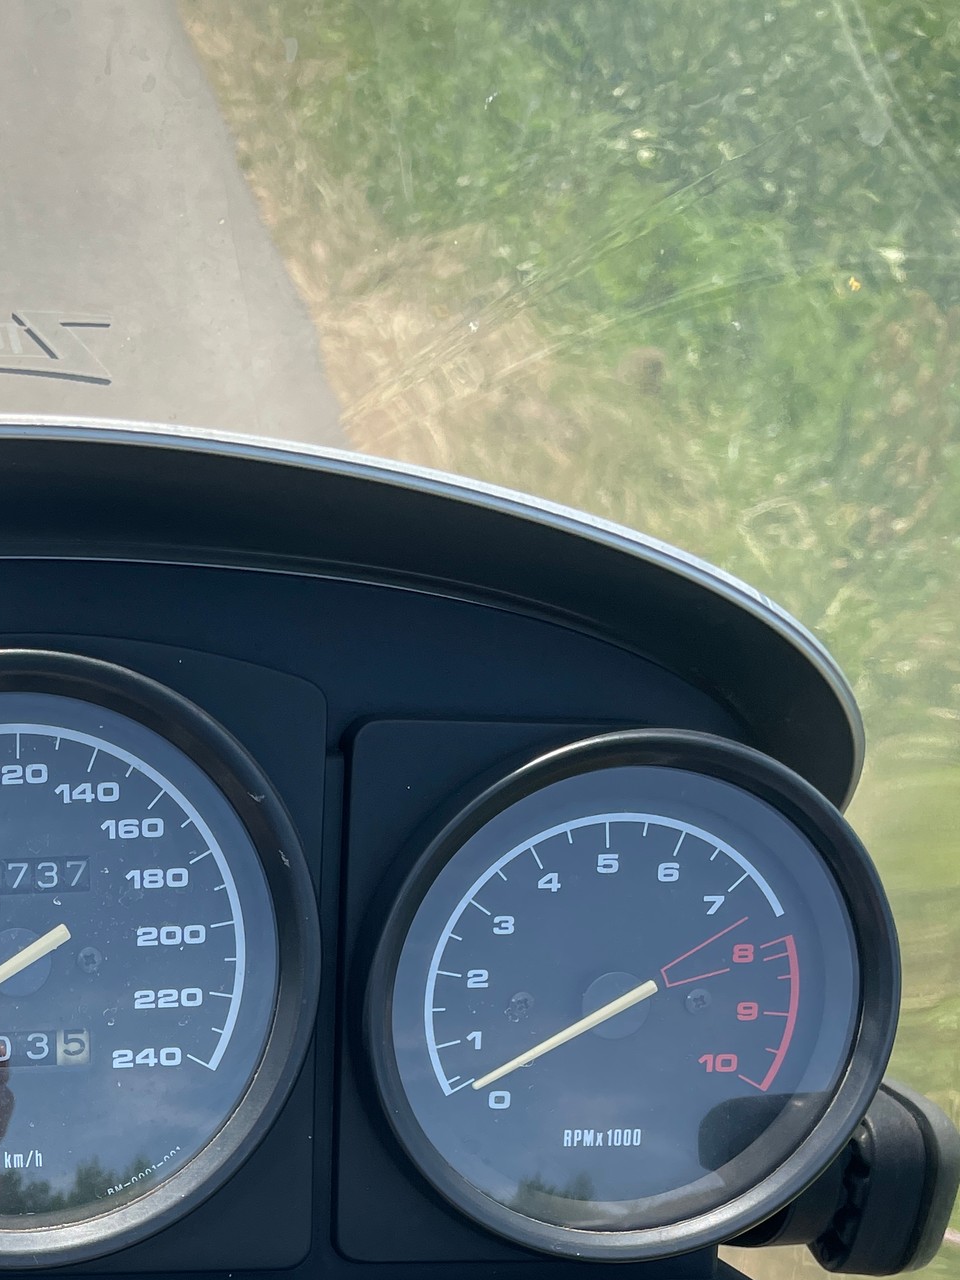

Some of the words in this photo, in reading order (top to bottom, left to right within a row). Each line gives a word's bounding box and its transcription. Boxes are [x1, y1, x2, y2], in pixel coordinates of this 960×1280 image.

[54, 782, 120, 804] 140
[100, 818, 165, 839] 160
[597, 854, 620, 874] 5
[657, 863, 680, 882] 6
[125, 868, 188, 888] 180
[537, 873, 562, 892] 4
[703, 896, 725, 914] 7
[493, 916, 515, 935] 3
[136, 925, 206, 946] 200
[732, 944, 755, 963] 8
[467, 970, 489, 988] 2
[134, 988, 203, 1009] 220
[736, 1002, 759, 1021] 9
[466, 1032, 483, 1049] 1
[112, 1047, 182, 1068] 240
[698, 1054, 738, 1072] 10
[489, 1091, 511, 1109] 0
[4, 1150, 44, 1168] km/h
